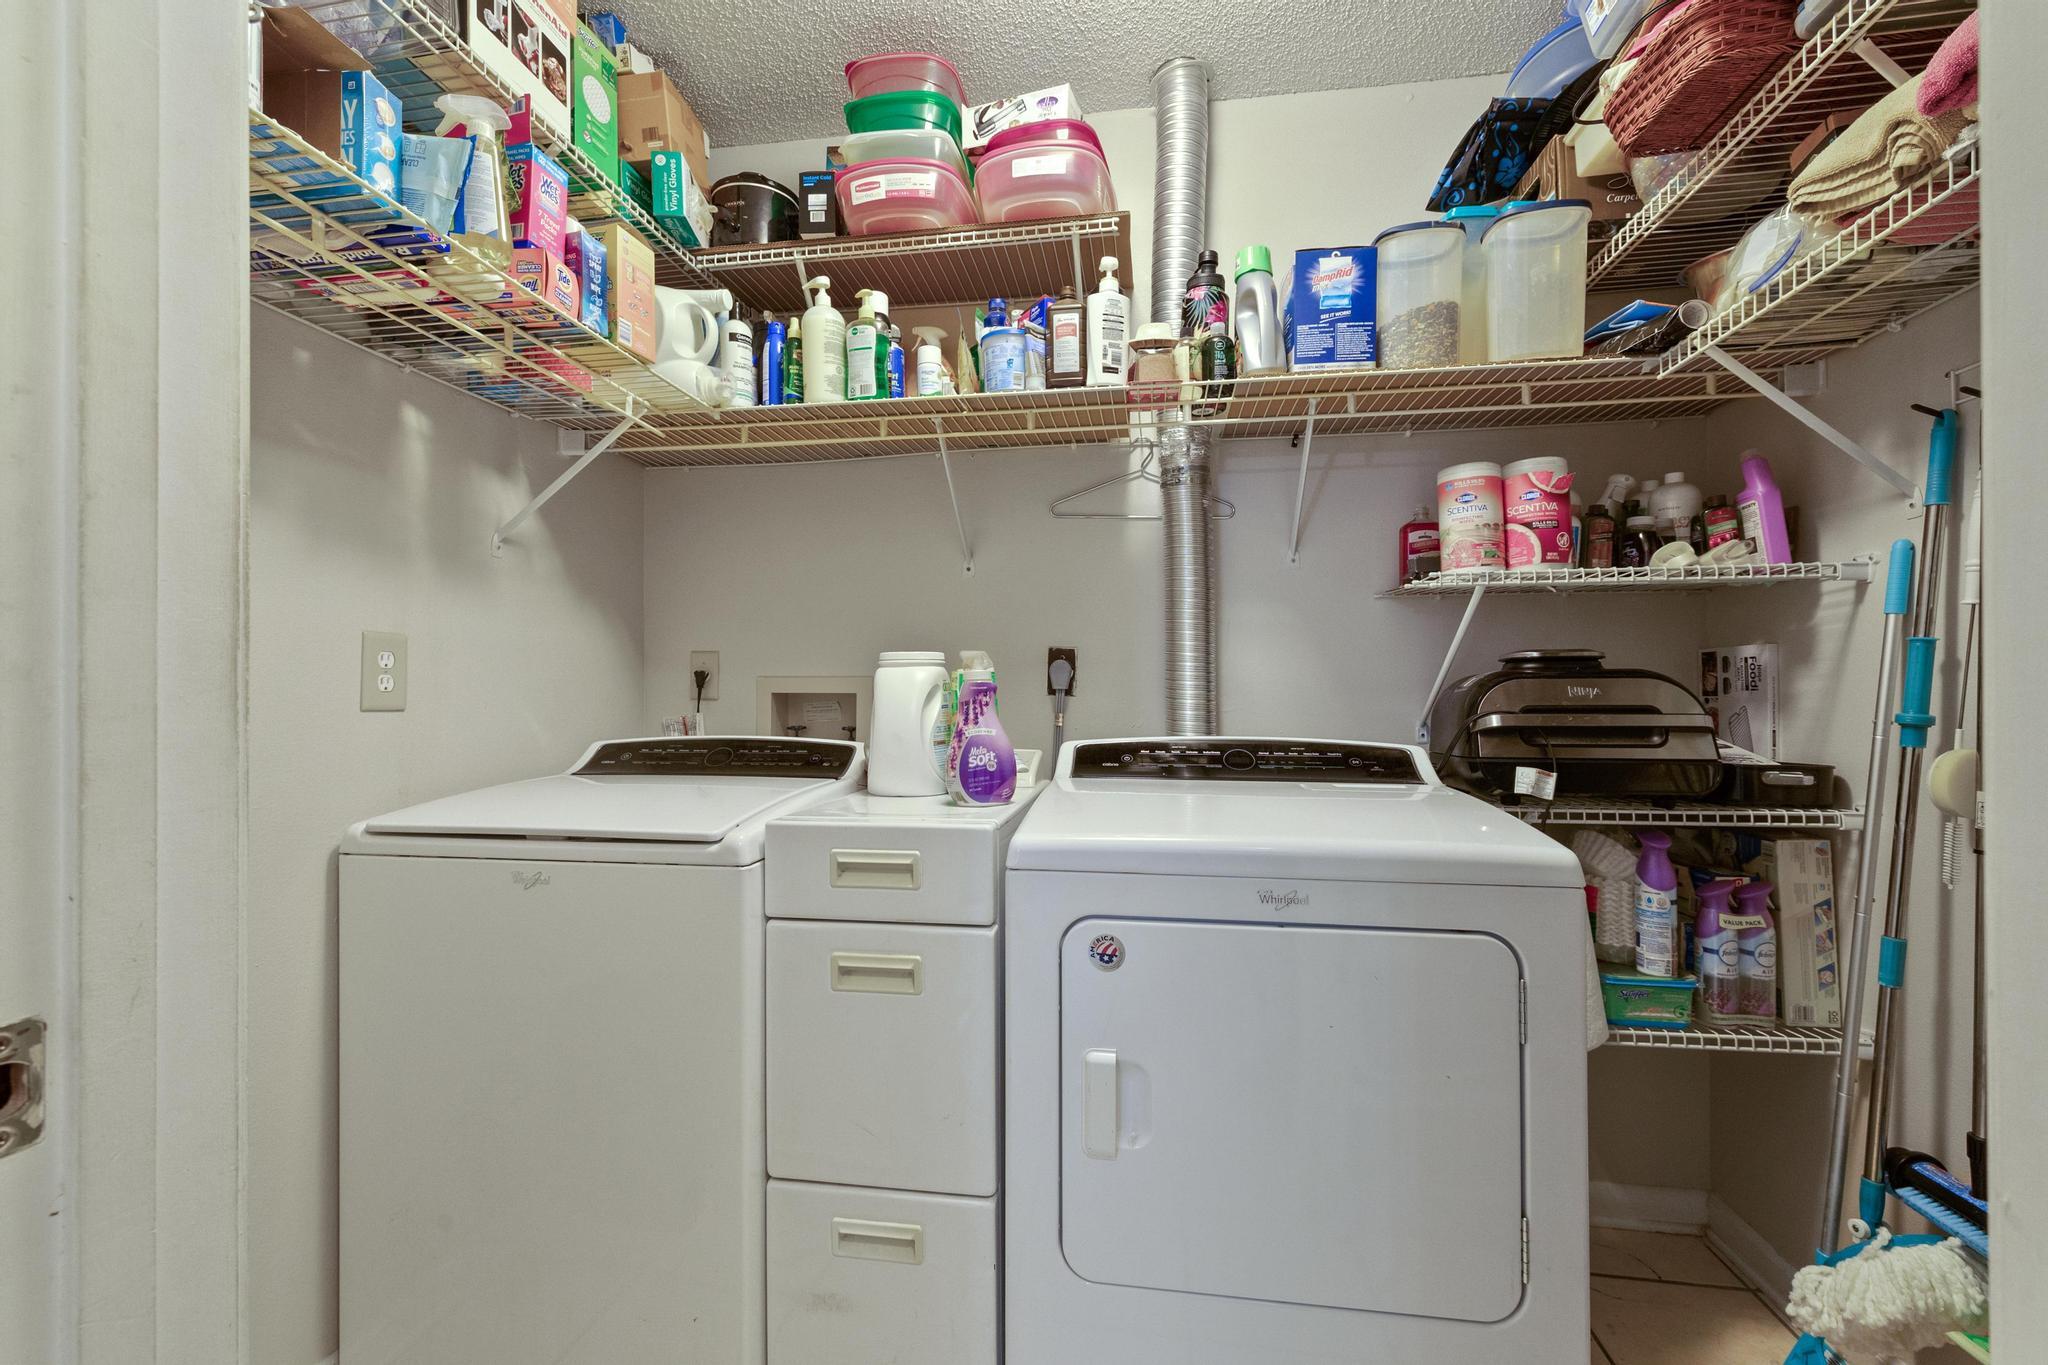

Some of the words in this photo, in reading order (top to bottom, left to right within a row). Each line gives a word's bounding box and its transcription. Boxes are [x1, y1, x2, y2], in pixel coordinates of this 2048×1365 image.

[668, 158, 677, 188] Gloves
[540, 184, 559, 205] Ones
[542, 174, 560, 197] Wet
[668, 189, 680, 211] Vinyl
[540, 219, 558, 236] Packs
[543, 214, 561, 231] Travel
[556, 268, 572, 287] Tide
[1311, 266, 1355, 286] DampRid
[1447, 504, 1488, 516] SCENTIVA
[1507, 502, 1558, 517] SCENTIVA
[1259, 893, 1309, 905] Whirlpool
